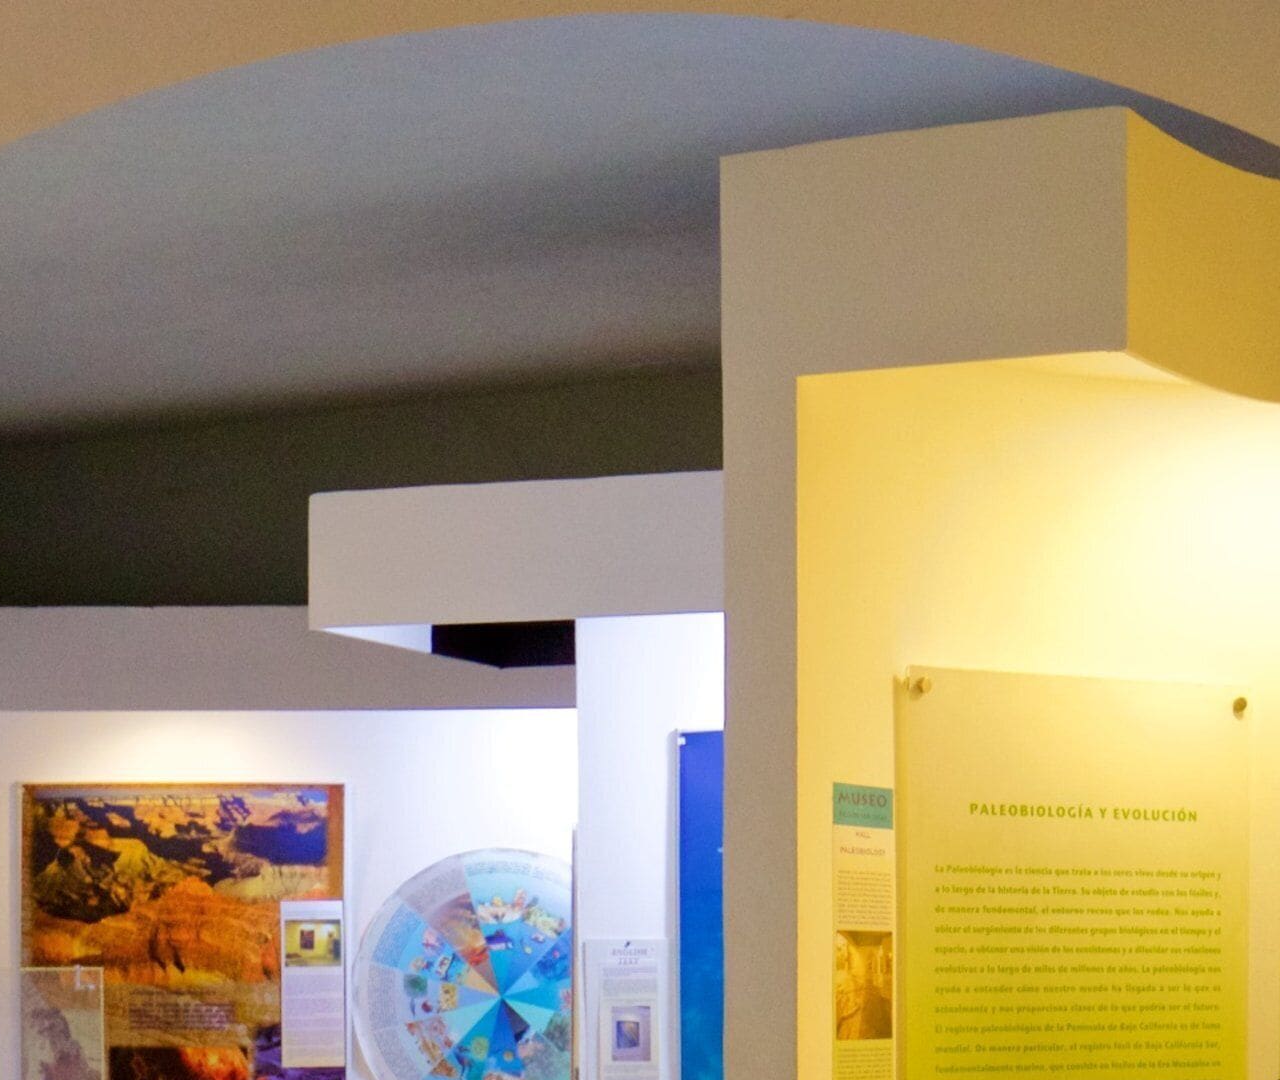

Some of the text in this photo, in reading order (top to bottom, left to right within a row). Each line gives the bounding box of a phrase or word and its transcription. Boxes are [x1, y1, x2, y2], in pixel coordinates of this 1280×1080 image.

[838, 791, 888, 808] MUSEO
[969, 803, 1199, 822] PALEOBIOLOGÍA Y EVOLUCIÓN
